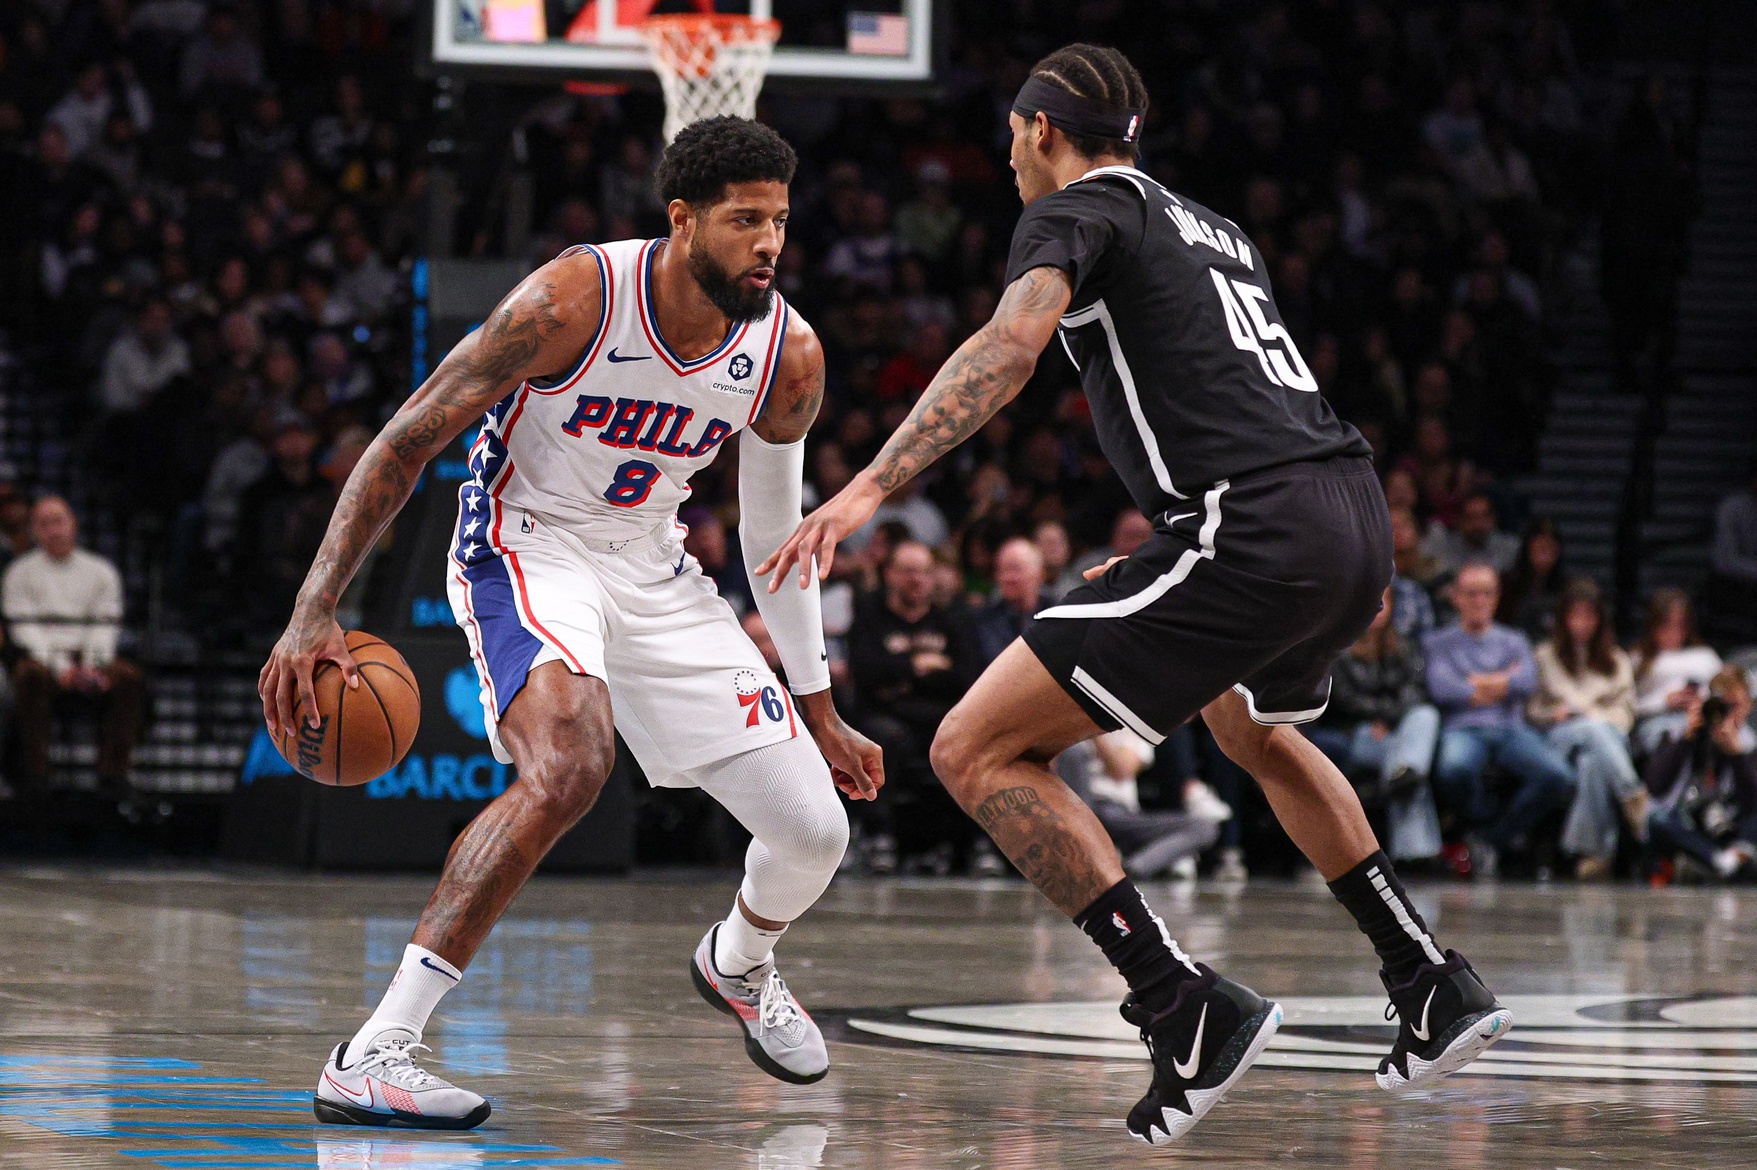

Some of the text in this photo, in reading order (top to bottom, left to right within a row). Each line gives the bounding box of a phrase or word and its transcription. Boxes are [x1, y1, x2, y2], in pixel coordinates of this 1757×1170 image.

[1209, 266, 1319, 392] 45
[712, 382, 755, 395] crypto.com
[561, 394, 733, 458] PHILA
[603, 459, 662, 508] 8
[736, 685, 784, 729] 76
